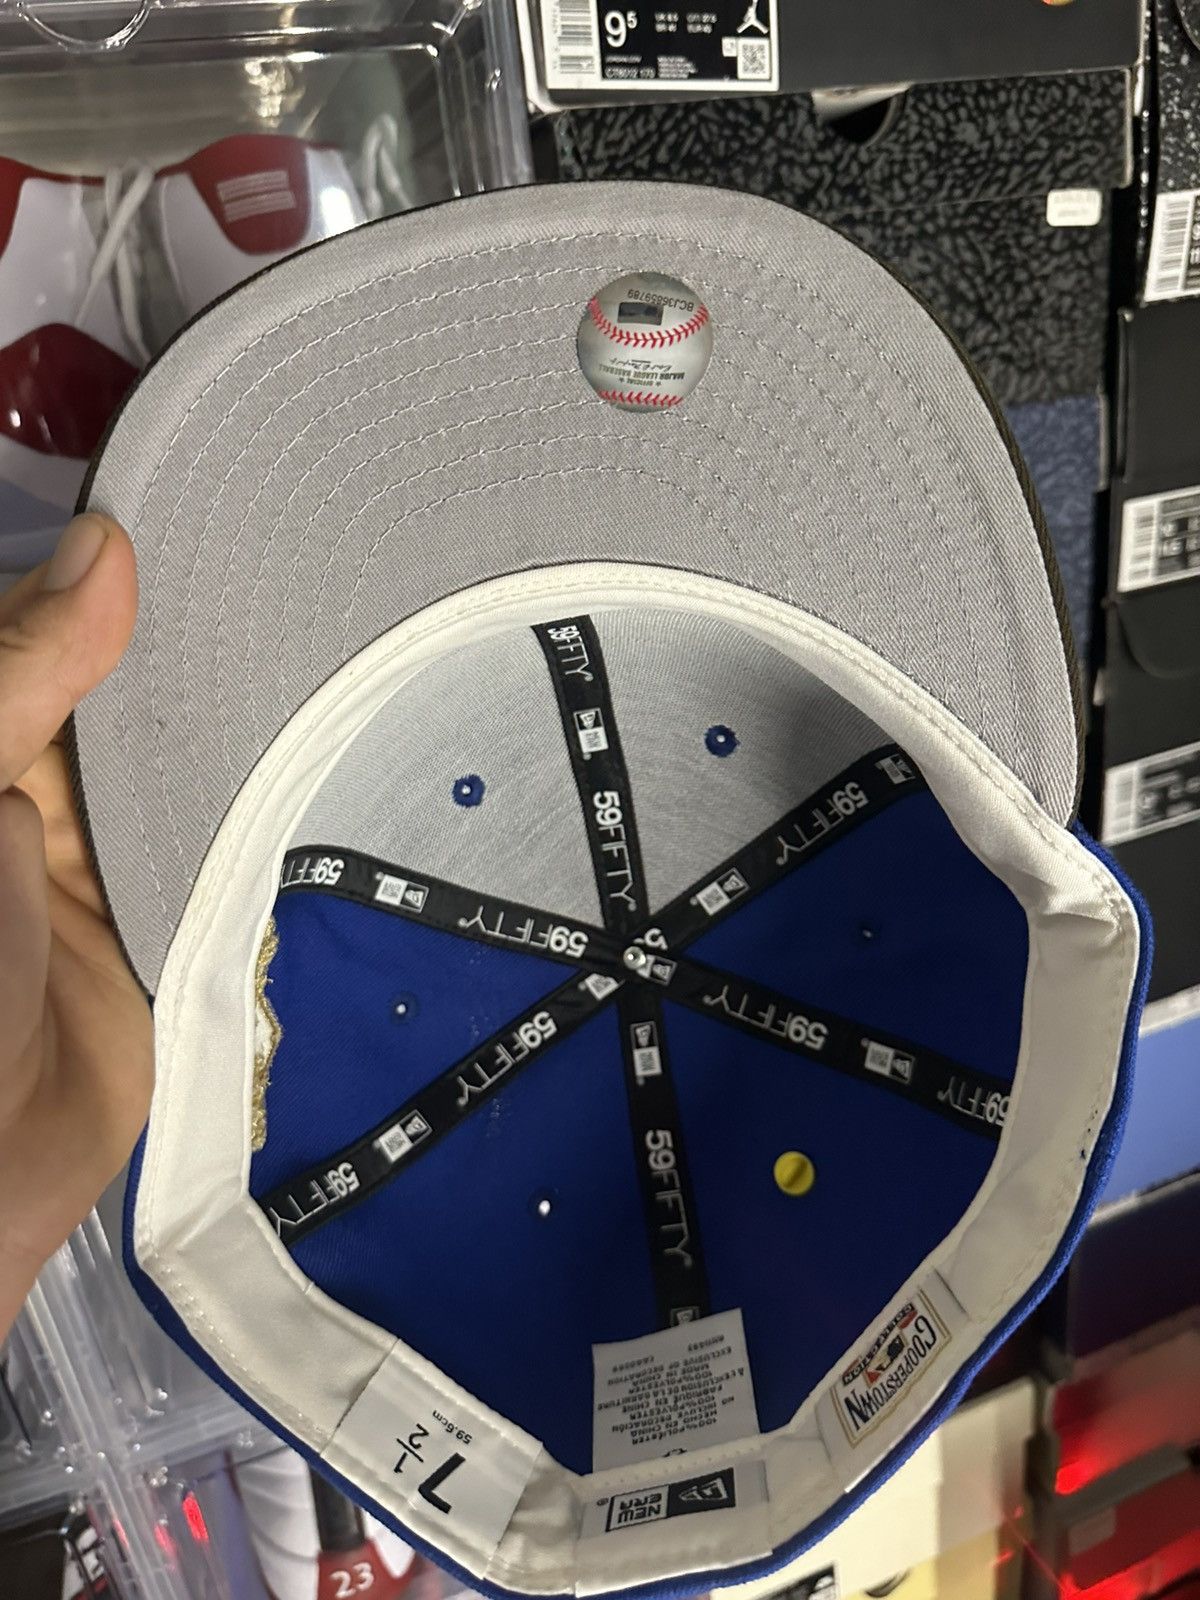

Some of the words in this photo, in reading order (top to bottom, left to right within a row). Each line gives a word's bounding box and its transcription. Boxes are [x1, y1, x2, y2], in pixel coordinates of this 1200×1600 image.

[599, 363, 632, 377] BASEBALL
[633, 371, 659, 379] LEAGUE
[660, 372, 685, 380] MAJOR
[593, 790, 635, 908] 59FIFTY
[777, 781, 869, 864] 59FIFTY
[458, 905, 589, 958] 59FIFTY
[704, 984, 829, 1050] 59FIFTY
[457, 1010, 558, 1105] 59FIFTY
[646, 1129, 693, 1267] 59FIFTY
[843, 1314, 937, 1431] COOPERSTOWN
[432, 1410, 473, 1445] 59.6cm
[418, 1452, 466, 1515] 7
[620, 1492, 662, 1510] ERA
[617, 1504, 662, 1524] NEW
[329, 1562, 375, 1599] 23
